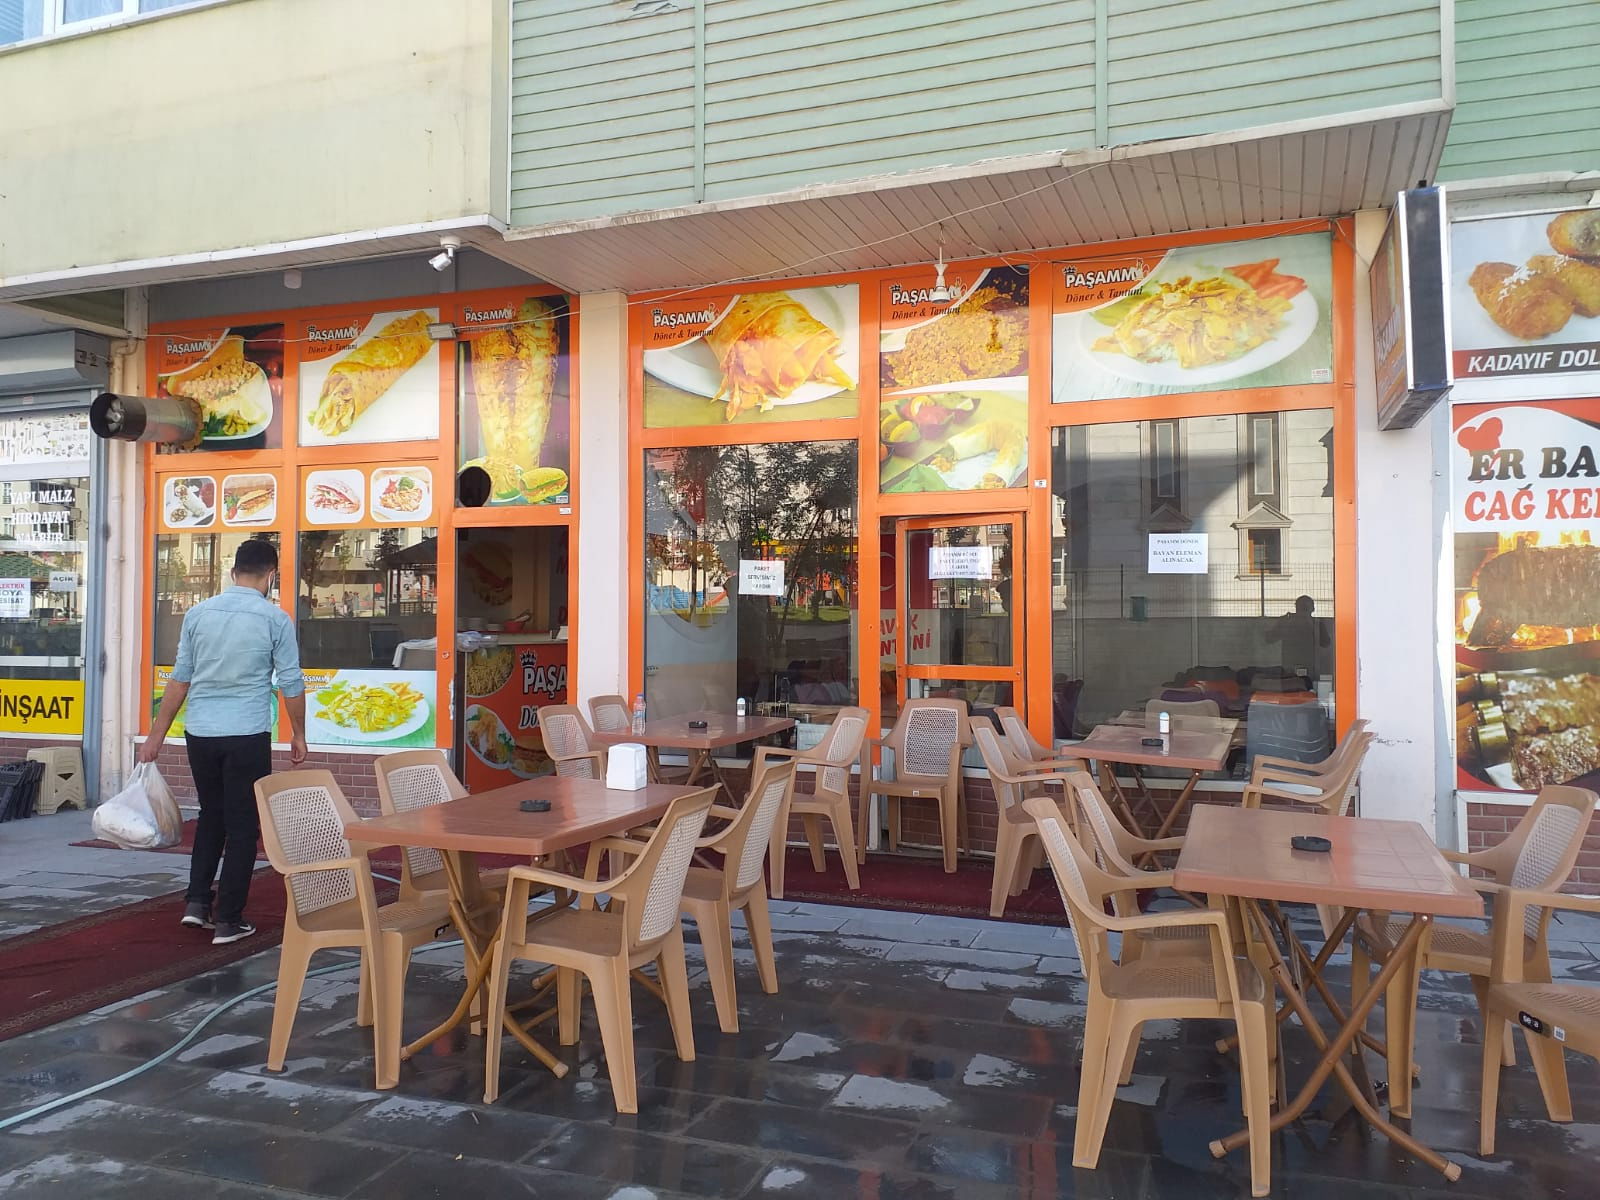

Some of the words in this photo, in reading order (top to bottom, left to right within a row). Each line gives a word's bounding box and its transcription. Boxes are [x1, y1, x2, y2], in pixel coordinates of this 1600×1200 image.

[1065, 292, 1095, 303] Döner
[1096, 290, 1105, 300] &
[892, 310, 918, 320] Döner
[919, 307, 927, 317] &
[653, 331, 677, 341] Döner
[677, 329, 685, 339] &
[1468, 351, 1554, 373] KADAYIF
[1468, 448, 1526, 481] ER
[1539, 445, 1600, 478] BA
[39, 489, 76, 504] MALZ.
